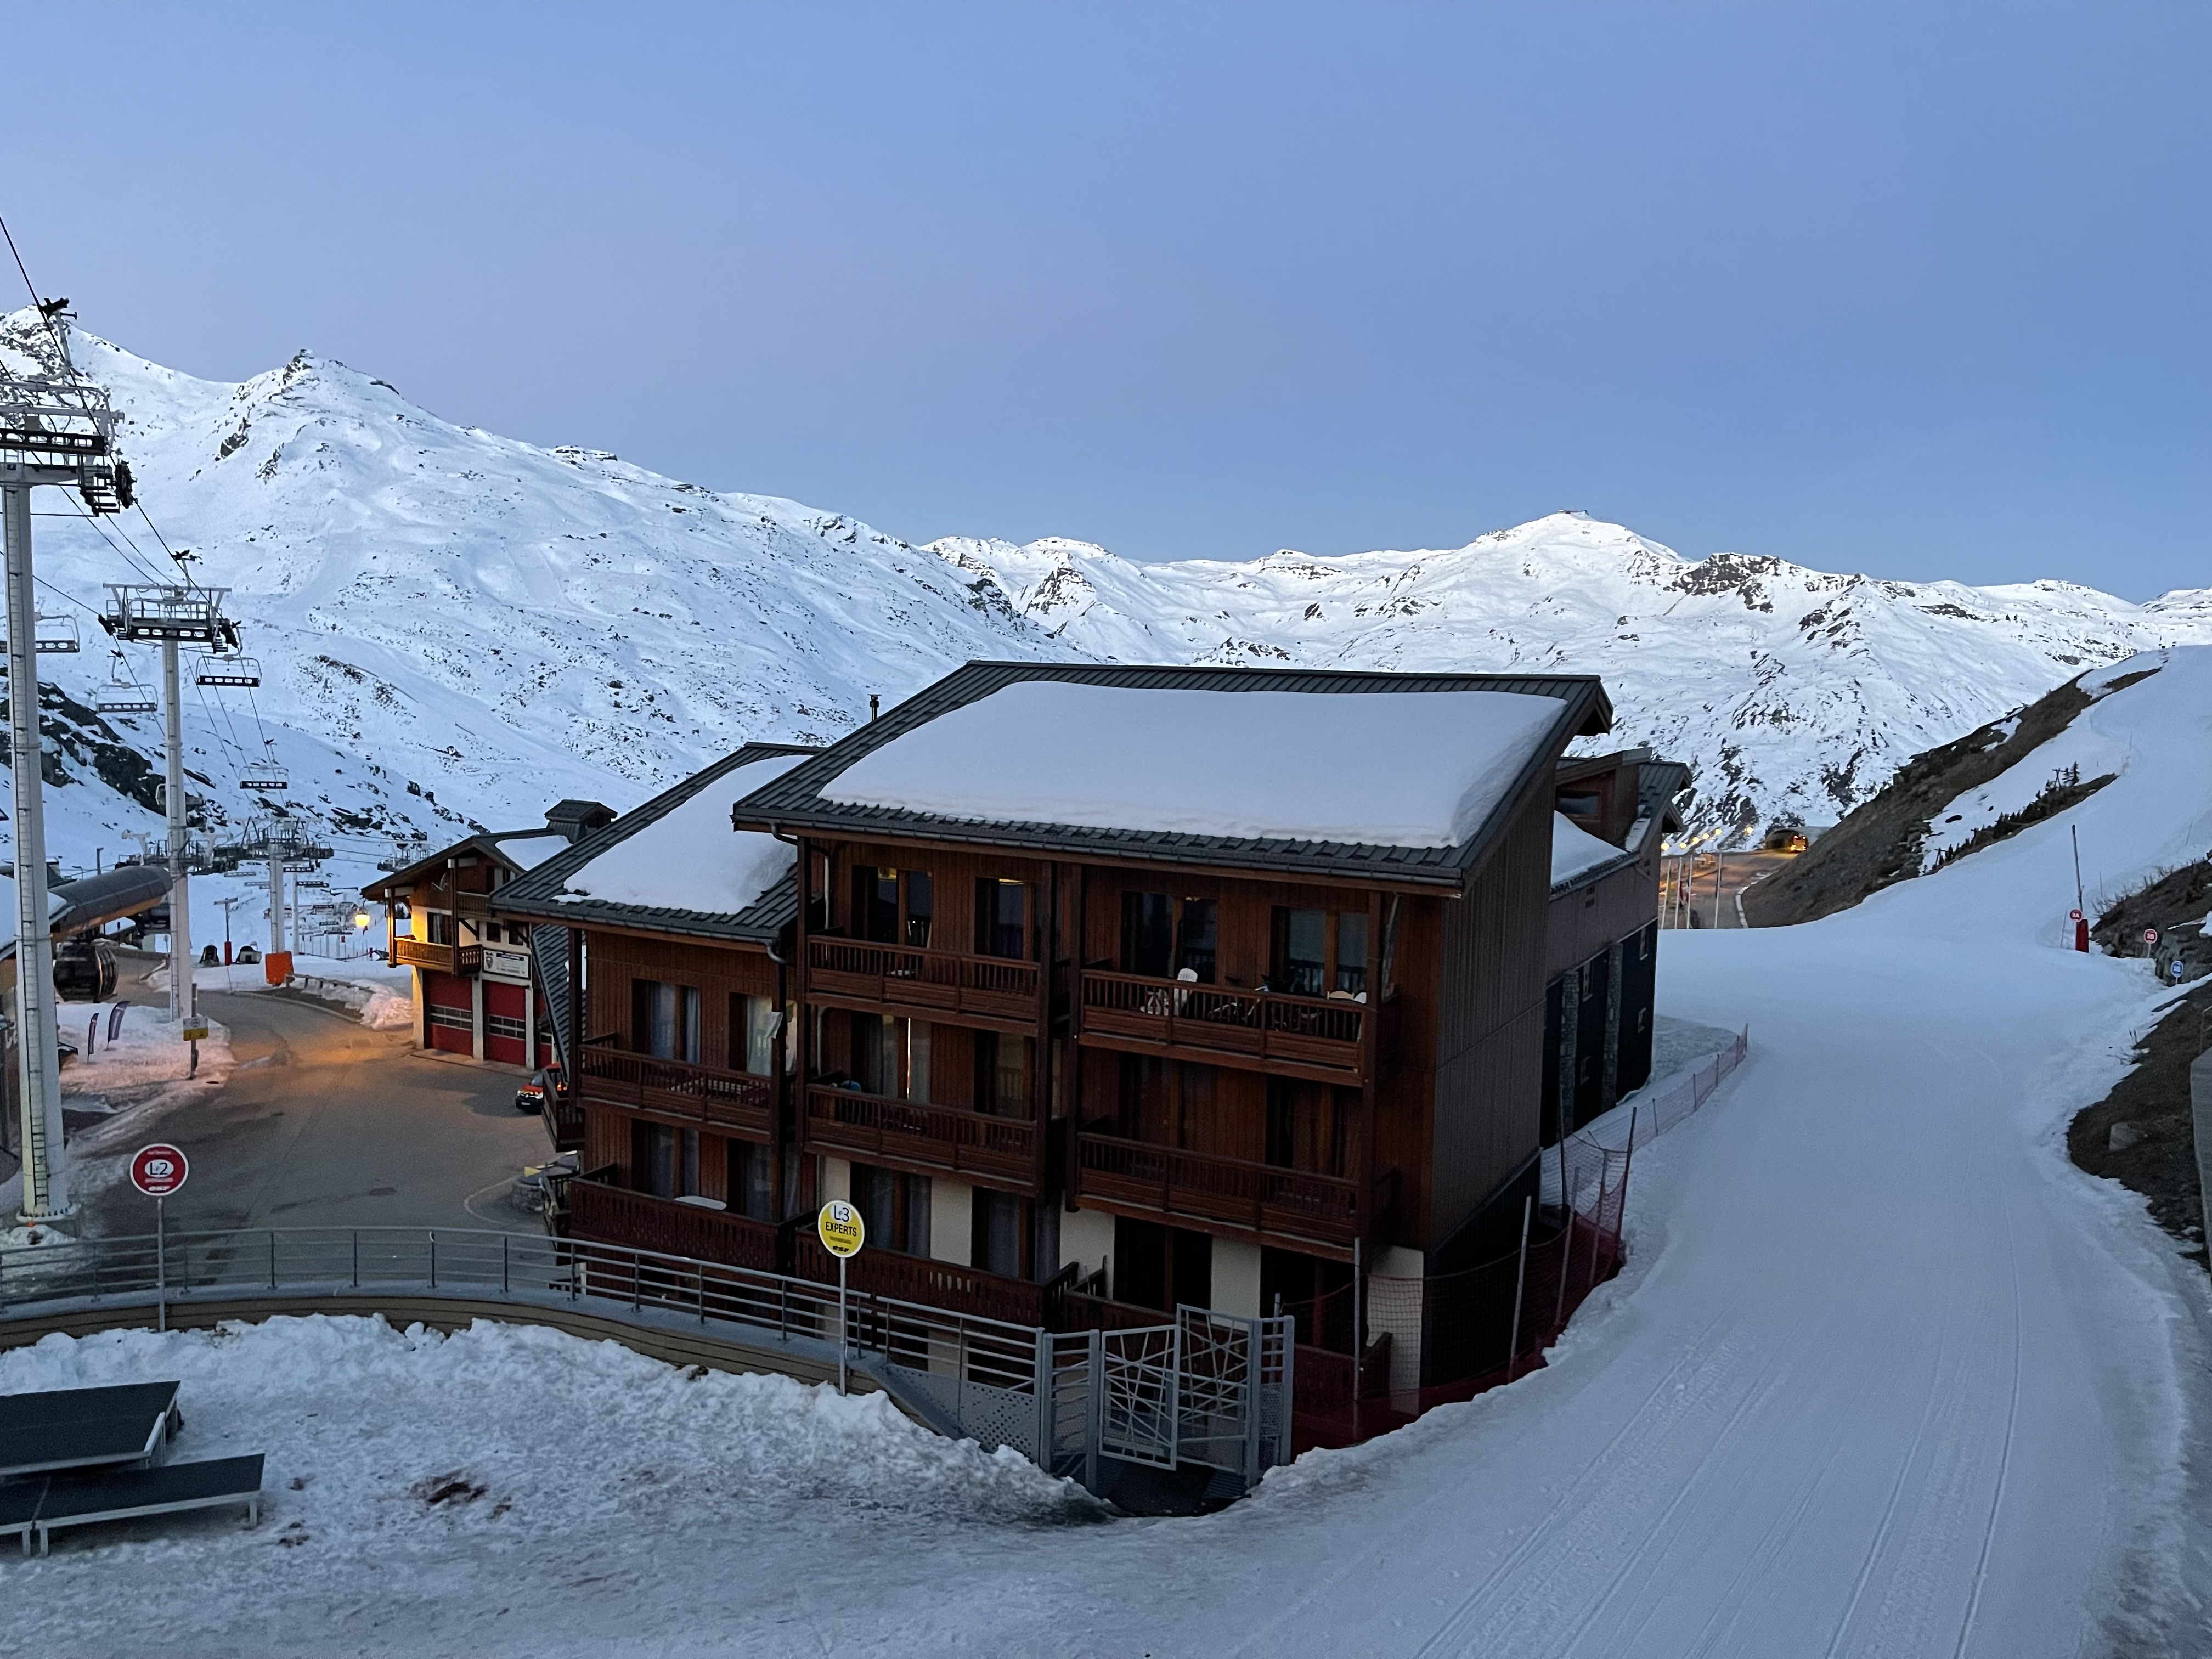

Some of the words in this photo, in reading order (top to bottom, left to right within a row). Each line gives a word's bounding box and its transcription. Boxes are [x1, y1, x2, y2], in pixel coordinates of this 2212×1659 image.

[150, 1162, 168, 1175] L2
[834, 1205, 849, 1222] L3
[825, 1221, 857, 1237] EXPERTS
